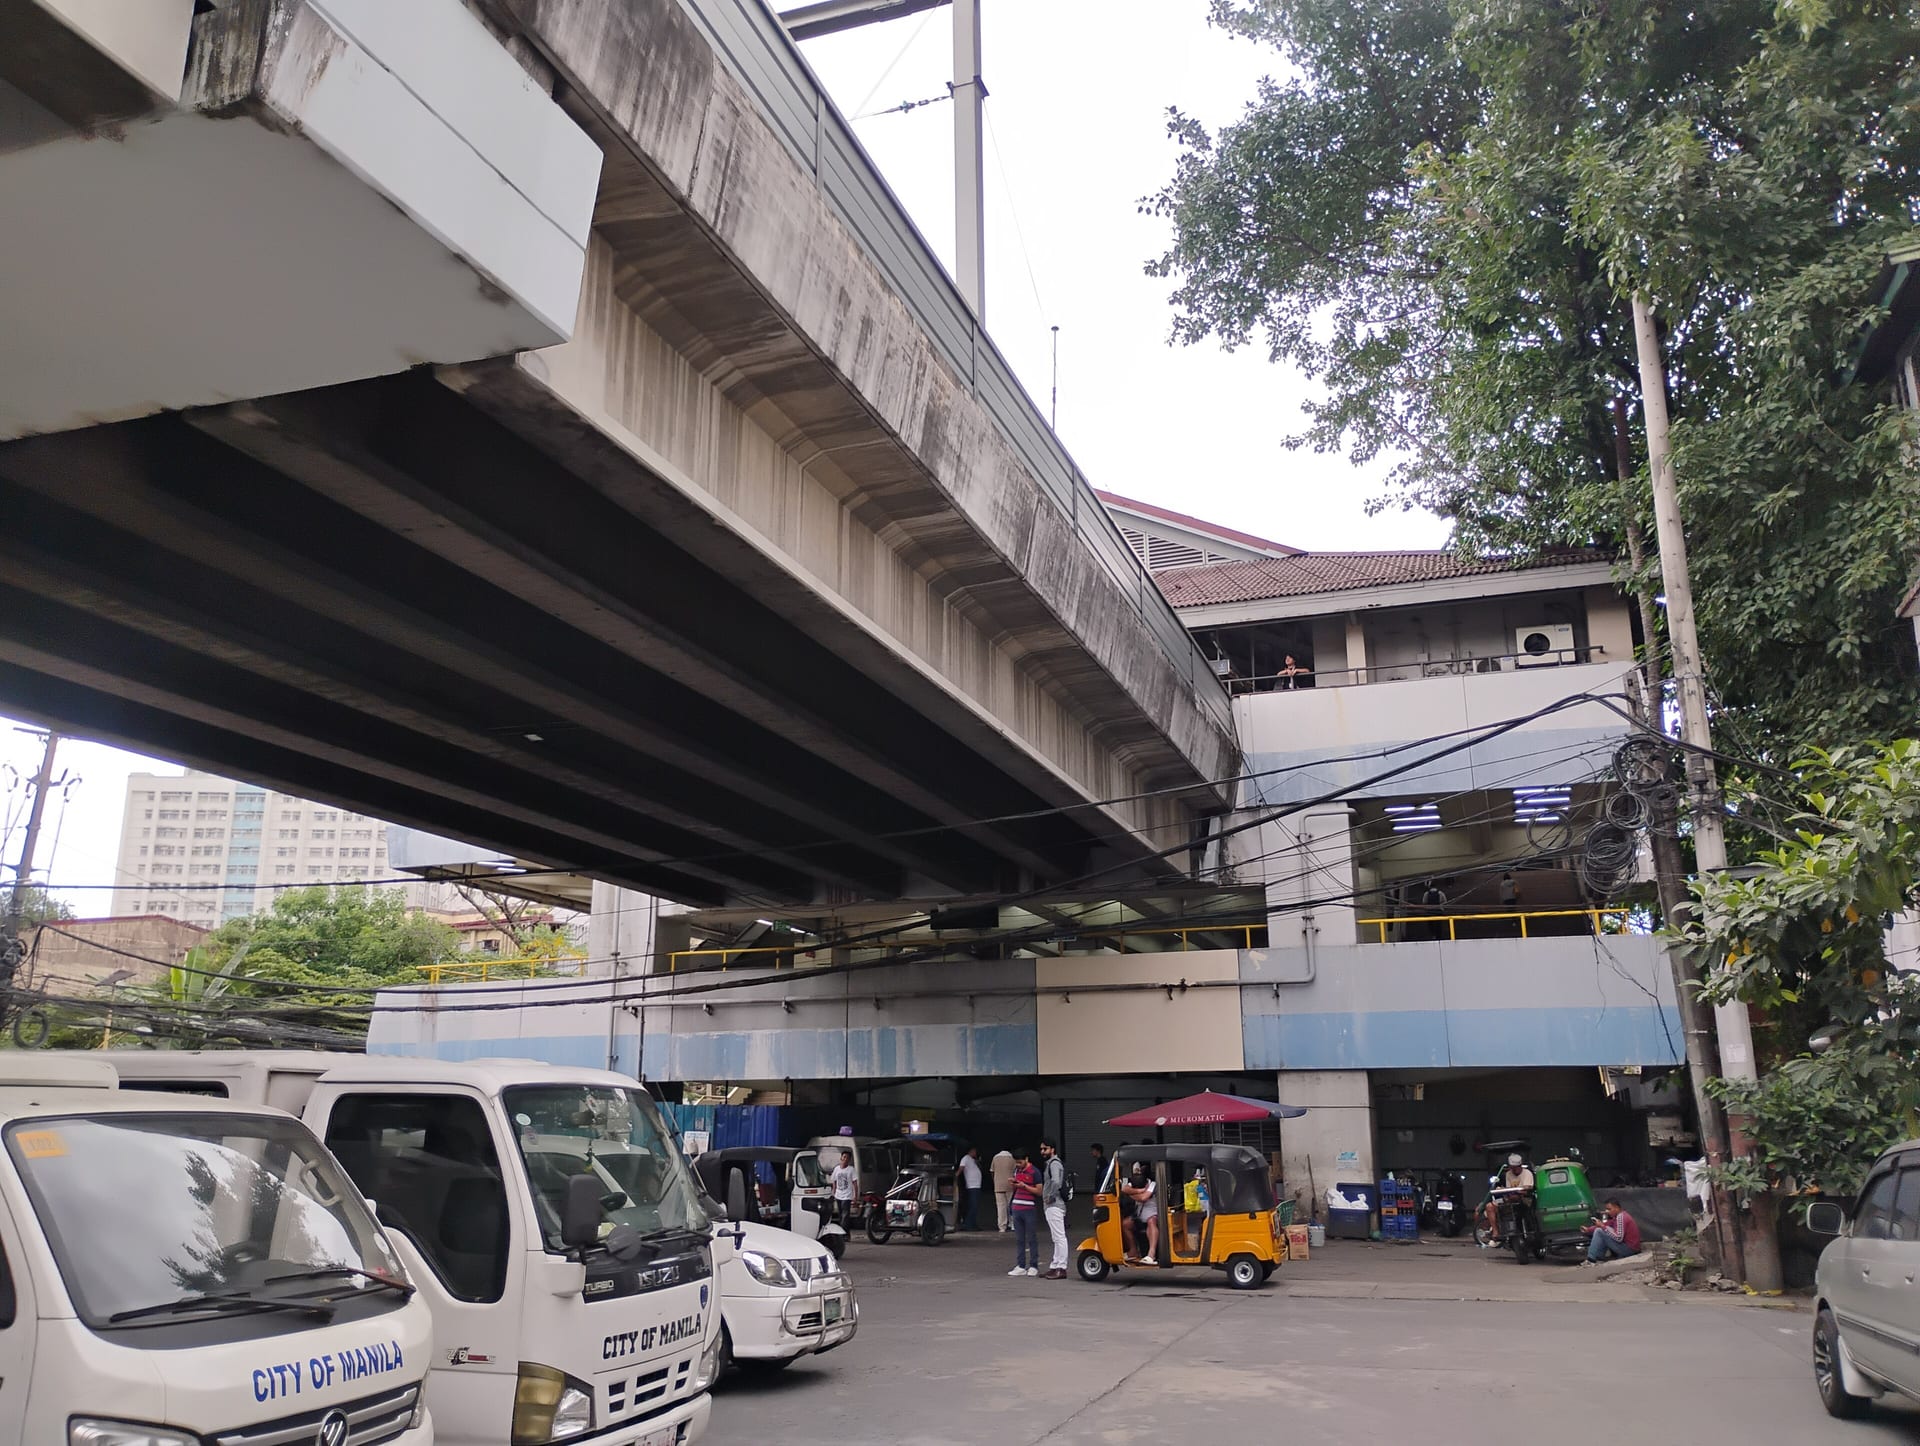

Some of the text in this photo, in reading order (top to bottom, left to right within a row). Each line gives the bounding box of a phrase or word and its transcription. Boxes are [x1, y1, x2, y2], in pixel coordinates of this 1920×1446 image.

[1170, 1114, 1225, 1123] MICROMATIC
[585, 1280, 615, 1292] TURBO
[638, 1265, 680, 1287] ISUZU
[602, 1312, 701, 1360] CITY OF MANILA
[252, 1340, 404, 1402] CITY OF MANILA
